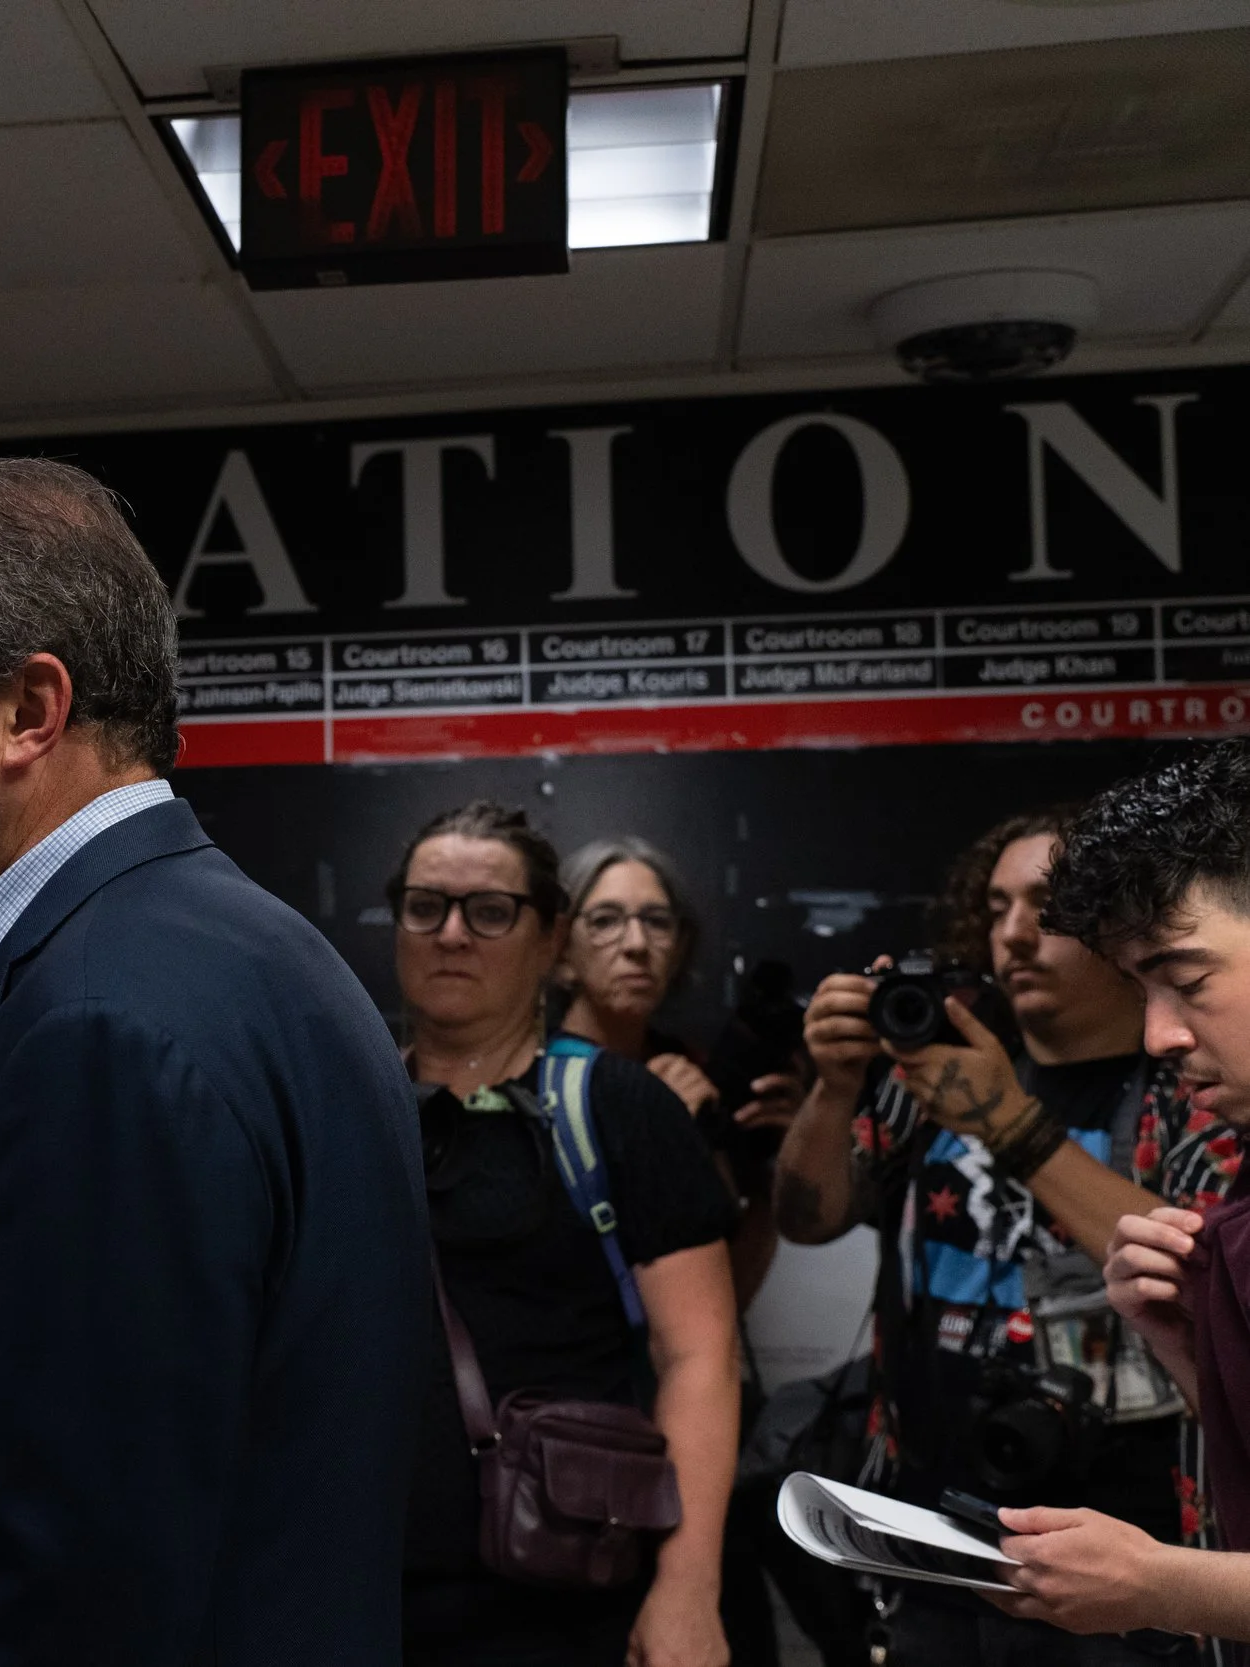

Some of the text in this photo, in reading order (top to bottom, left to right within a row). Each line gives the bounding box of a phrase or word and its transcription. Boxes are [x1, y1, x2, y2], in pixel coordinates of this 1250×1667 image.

[298, 76, 518, 244] EXIT
[956, 617, 1100, 644] Courtroom
[1172, 608, 1250, 636] Court
[541, 628, 711, 661] Courtroom 17
[744, 627, 884, 653] Courtroom
[180, 651, 278, 674] urtroom
[342, 643, 473, 668] Courtroom
[978, 653, 1118, 685] Judge Khan
[547, 668, 711, 699] Judge Kouris
[740, 658, 935, 693] Judge McFarland
[334, 680, 391, 708] Judge
[1020, 695, 1246, 729] COURTRO
